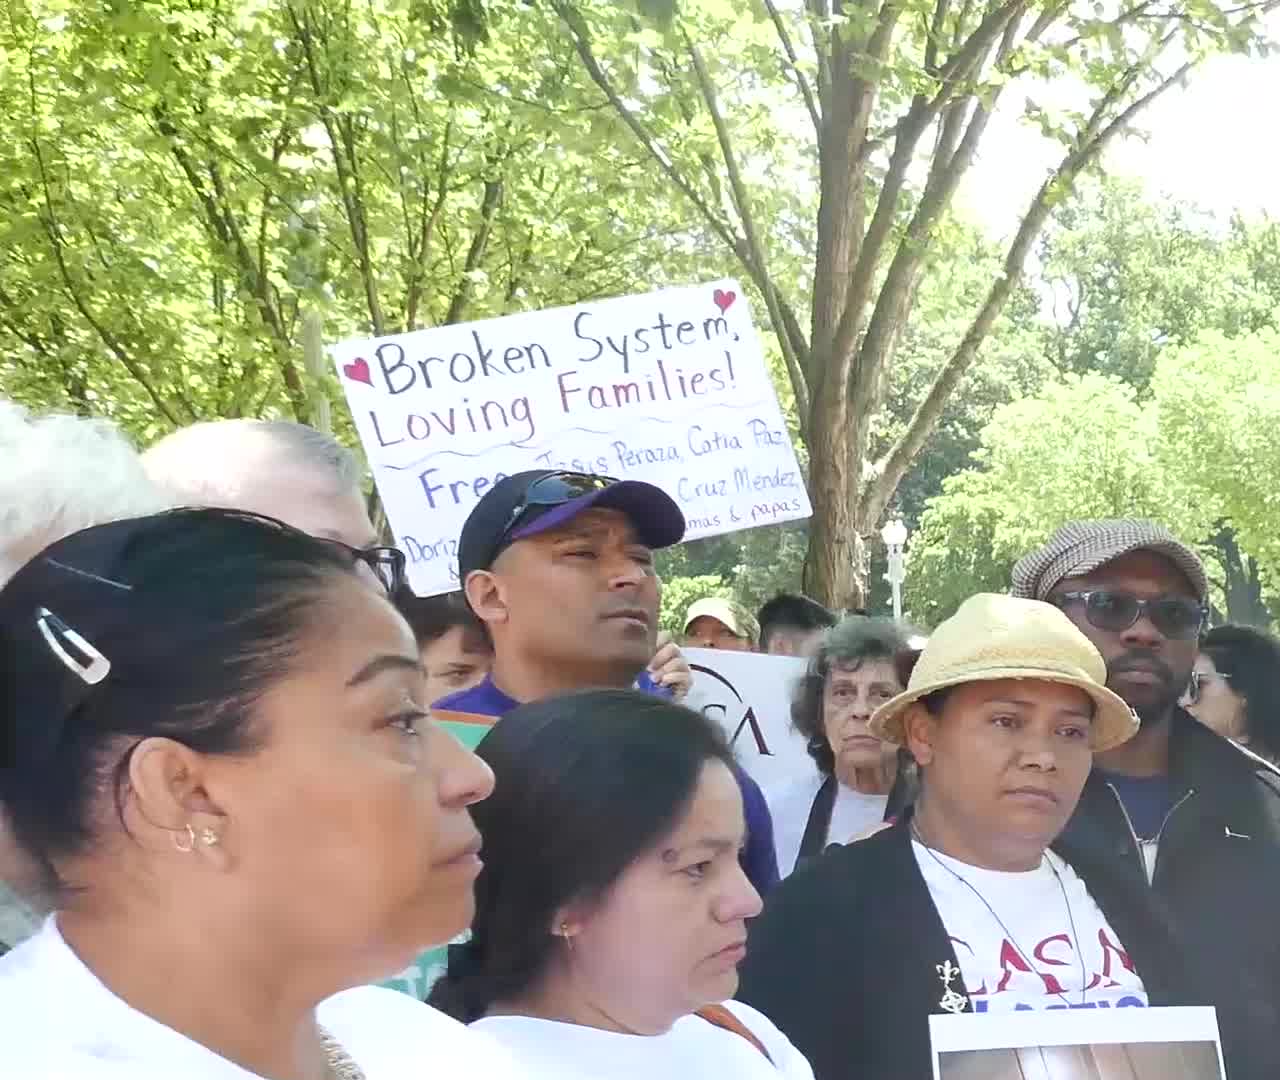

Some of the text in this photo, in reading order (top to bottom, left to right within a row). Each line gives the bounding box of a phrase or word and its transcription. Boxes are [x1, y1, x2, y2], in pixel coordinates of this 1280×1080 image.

[375, 330, 552, 396] Broken
[369, 350, 736, 448] Loving Families!
[685, 515, 721, 531] mas
